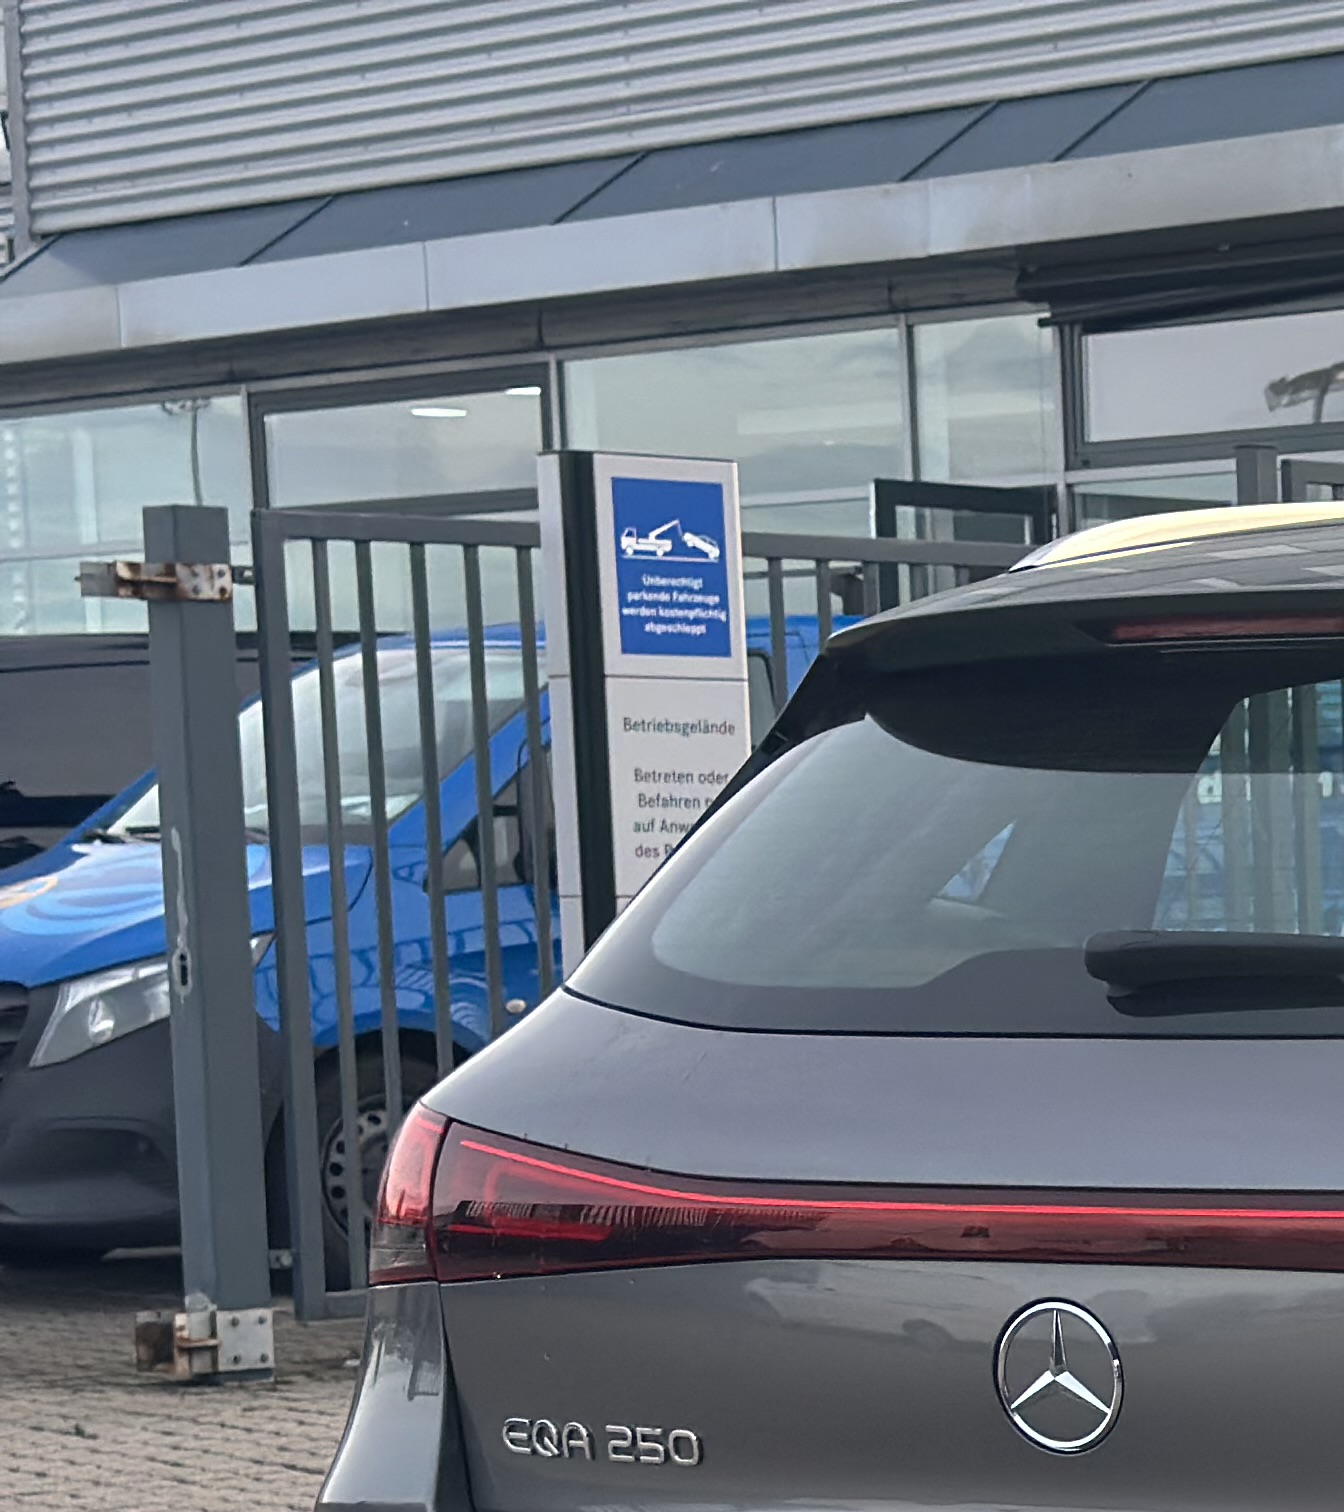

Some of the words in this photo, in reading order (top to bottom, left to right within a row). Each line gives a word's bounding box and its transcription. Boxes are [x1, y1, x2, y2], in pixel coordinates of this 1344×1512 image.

[642, 573, 703, 590] Unberechtigt
[627, 590, 671, 603] parkende
[673, 591, 720, 606] Fahrzeuge
[622, 606, 657, 617] werden
[659, 606, 727, 622] kostenpflichtig
[644, 621, 706, 636] abgeschleppt
[623, 717, 736, 738] Betriebsgelände
[634, 767, 693, 784] Betreten
[698, 770, 729, 785] oder
[638, 793, 701, 809] Befahren
[633, 818, 655, 833] auf
[634, 843, 660, 858] des
[502, 1417, 591, 1460] EQA
[605, 1425, 700, 1466] 250
